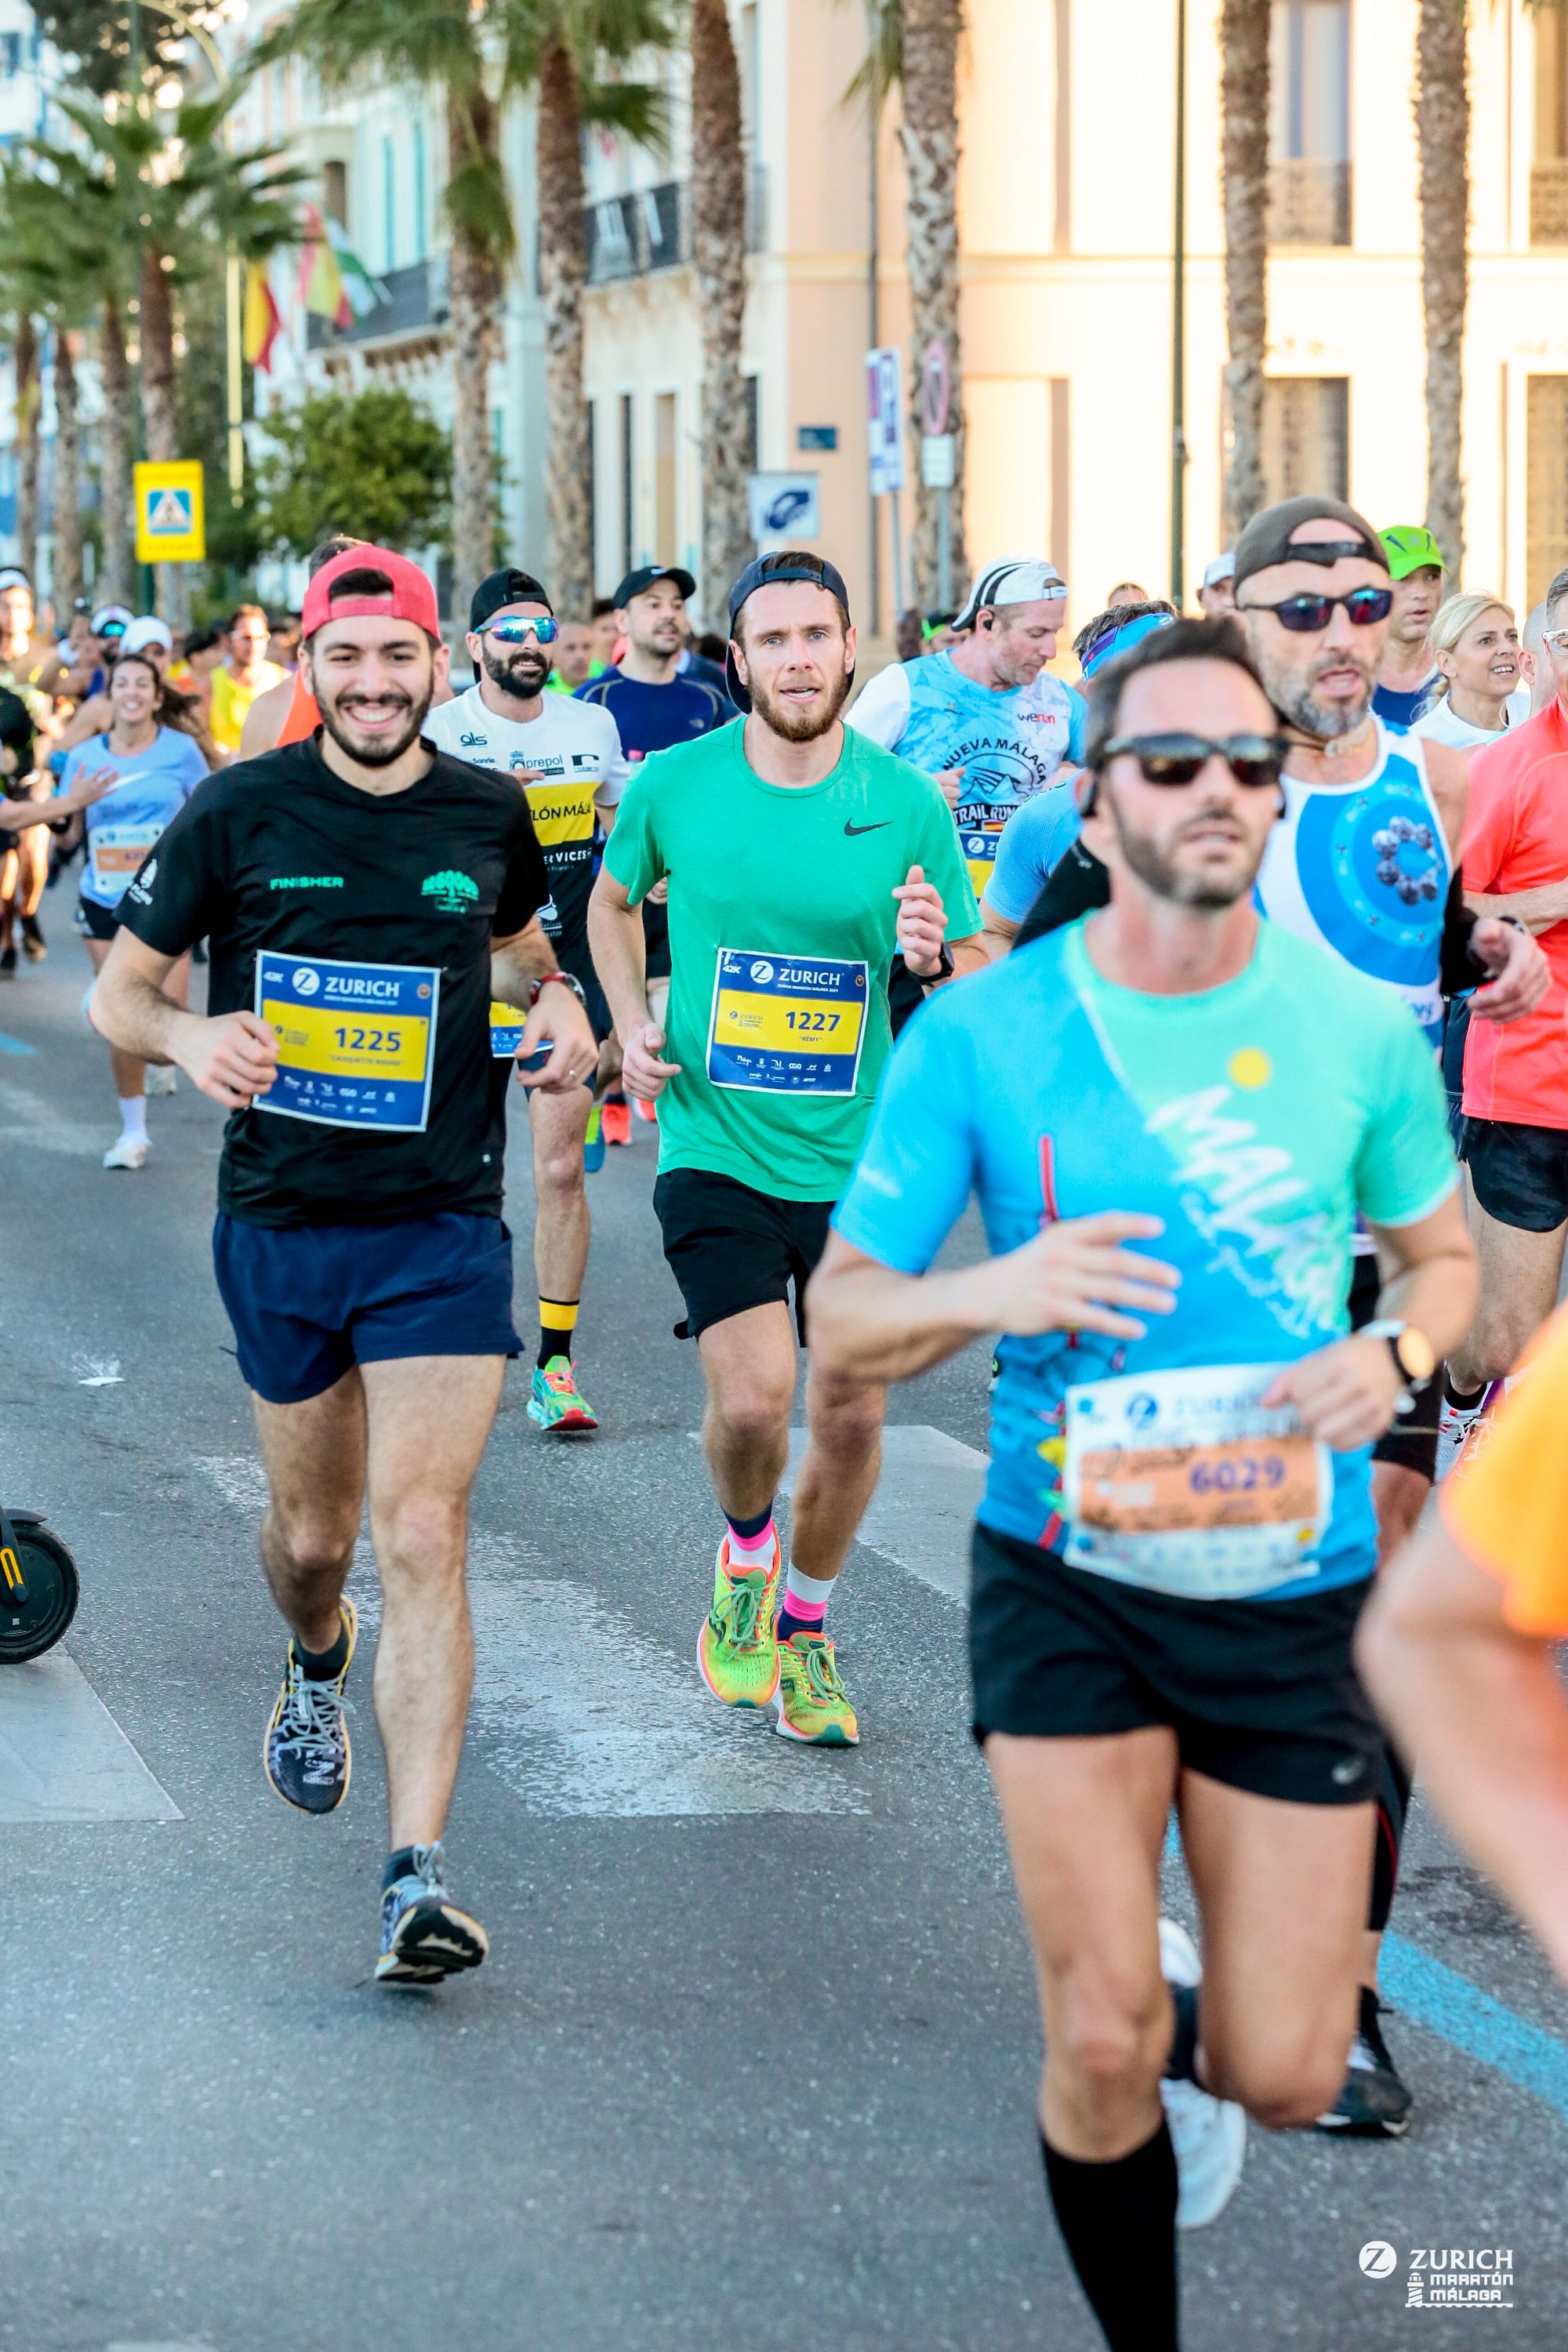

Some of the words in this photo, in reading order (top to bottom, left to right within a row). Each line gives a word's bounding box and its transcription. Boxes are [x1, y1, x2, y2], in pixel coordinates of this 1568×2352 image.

[270, 877, 343, 890] FINISHER
[324, 975, 401, 998] ZURICH
[779, 967, 841, 986] ZURICH
[786, 1011, 841, 1032] 1227
[335, 1027, 401, 1052] 1225
[1189, 1454, 1286, 1496] 6029
